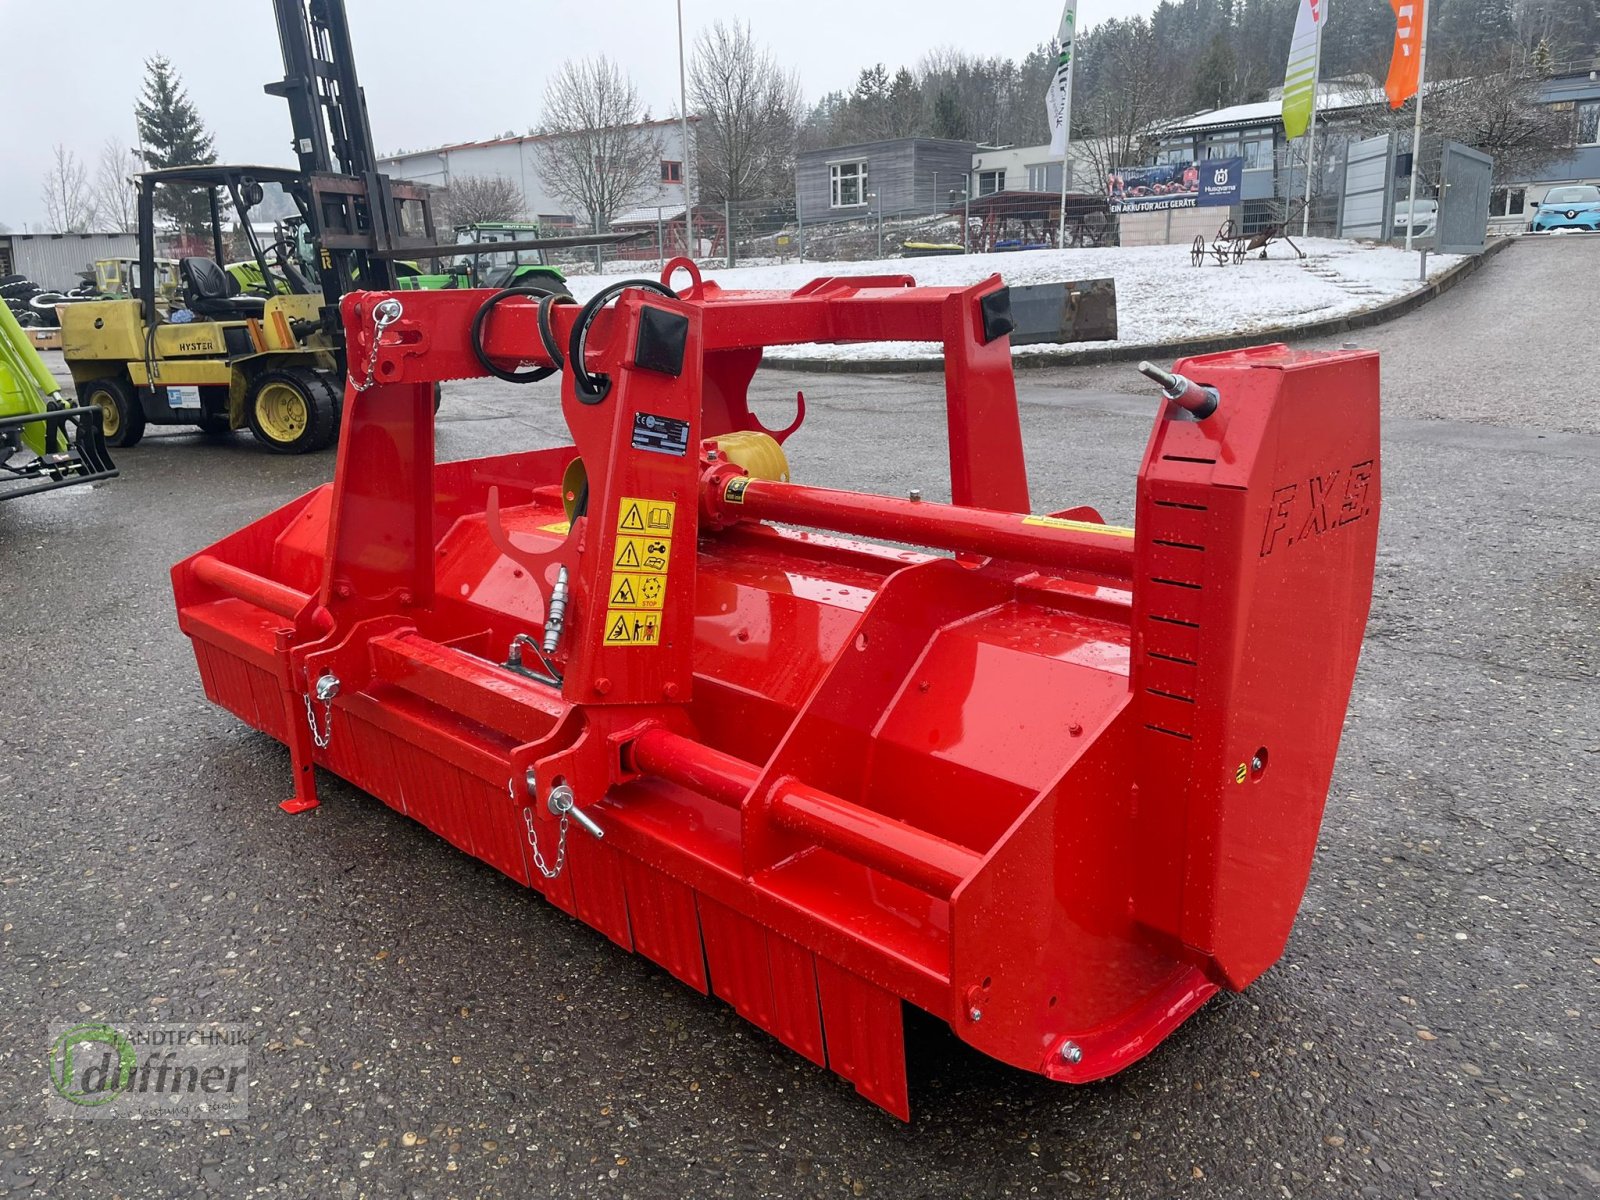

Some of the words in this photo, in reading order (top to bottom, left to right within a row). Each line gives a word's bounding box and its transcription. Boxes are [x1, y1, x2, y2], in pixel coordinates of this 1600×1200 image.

[1204, 184, 1236, 192] Husqvarna
[1111, 204, 1121, 212] EIN
[1122, 203, 1140, 212] AKKU
[1154, 201, 1169, 210] ALLE
[1170, 197, 1196, 208] GERÄTE
[179, 343, 213, 351] HYSTER
